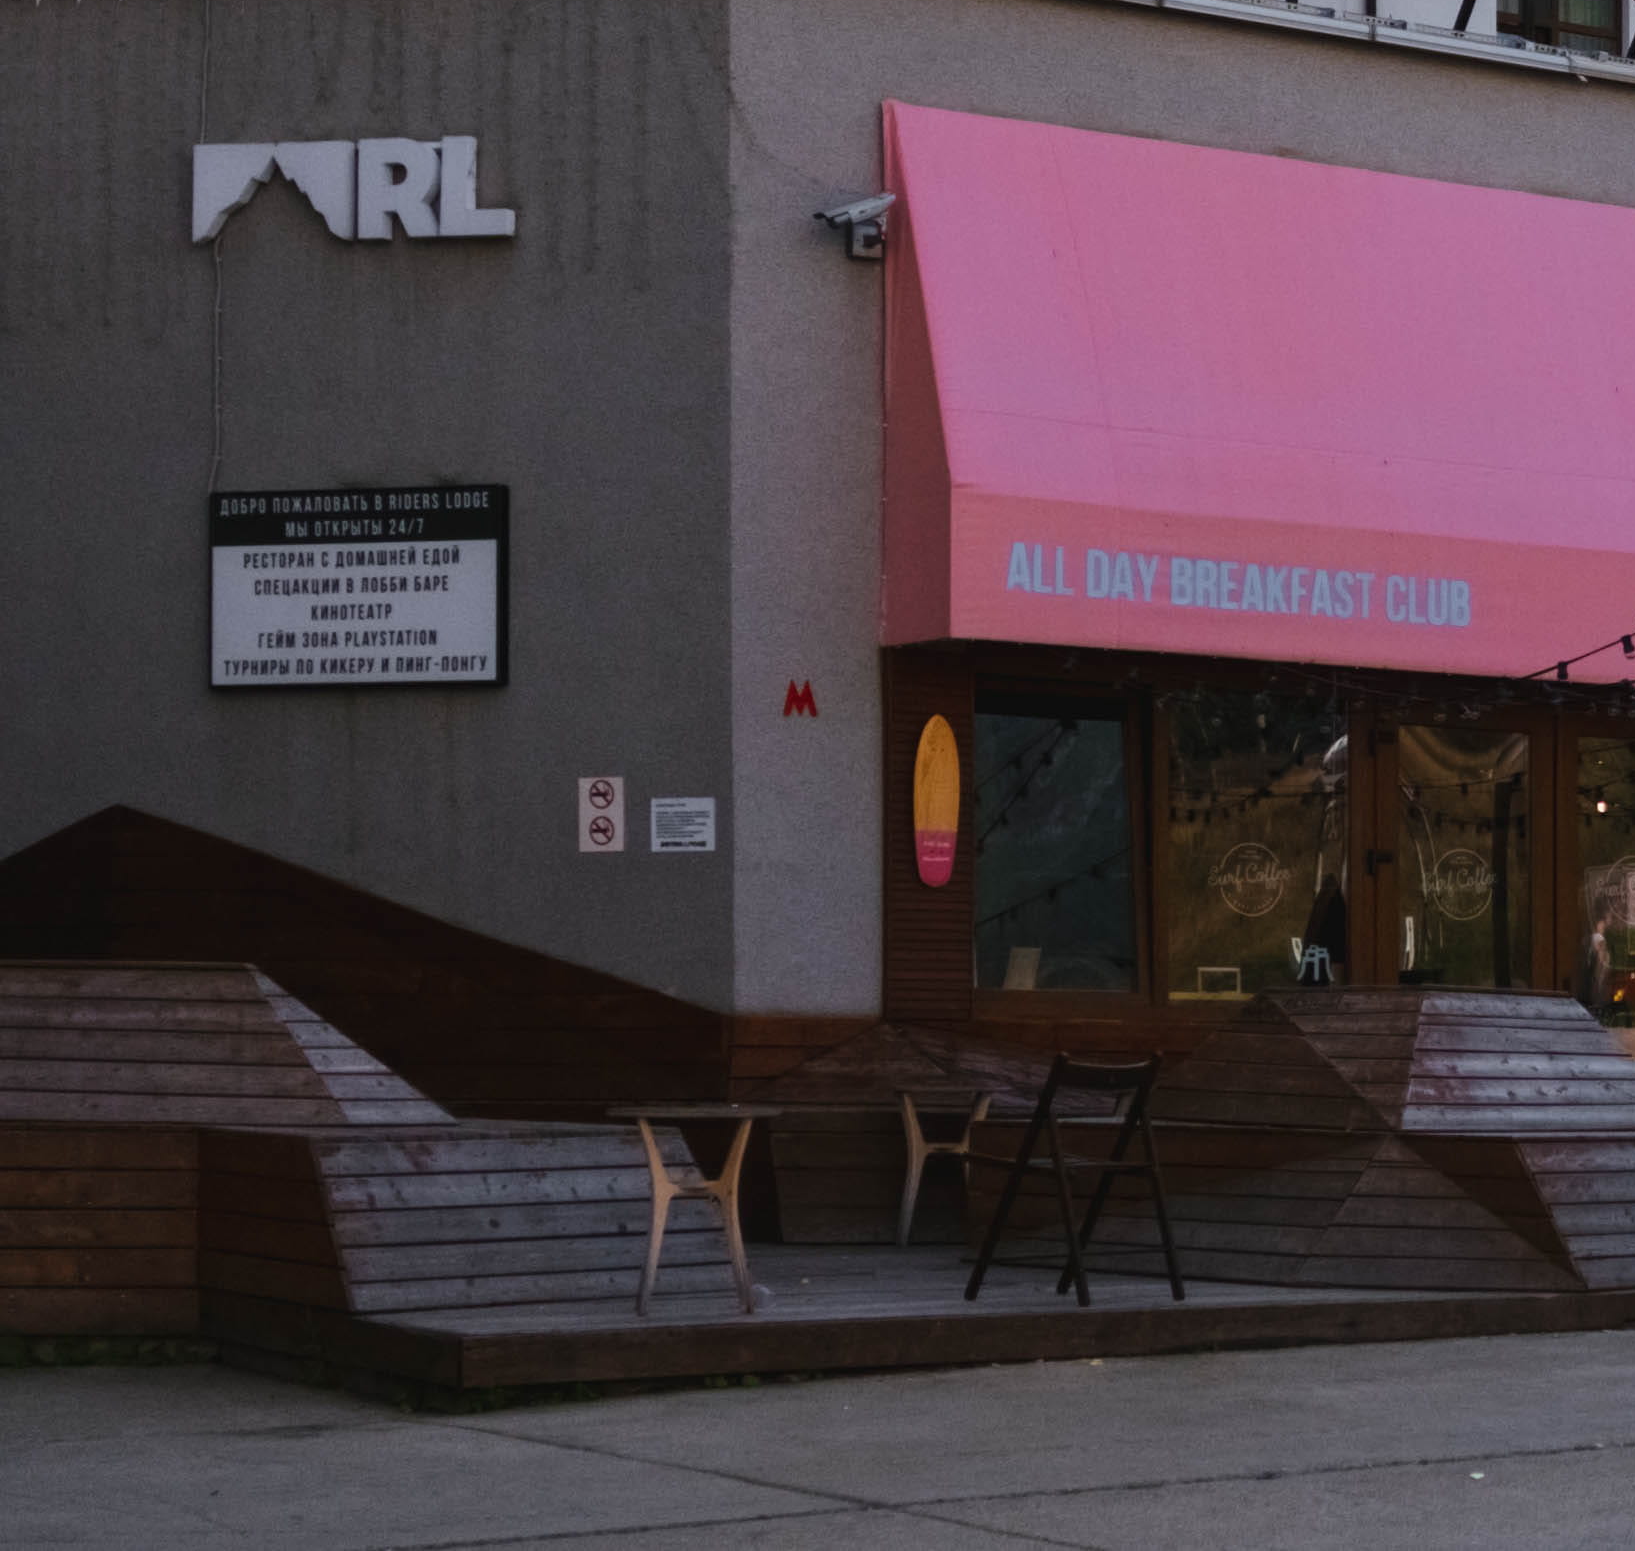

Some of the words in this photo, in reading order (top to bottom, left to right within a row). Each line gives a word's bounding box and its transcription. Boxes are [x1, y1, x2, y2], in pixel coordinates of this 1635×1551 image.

[220, 497, 266, 517] ДОБРО
[273, 494, 368, 514] ПОЖАЛОВАТЬ
[374, 494, 383, 511] В
[389, 492, 440, 511] RIDERS
[445, 491, 489, 510] LODGE
[285, 521, 308, 538] МЫ
[314, 518, 383, 537] ОТКРЫТЫ
[389, 518, 425, 536] 24/7
[243, 551, 314, 569] РЕСТОРАН
[321, 551, 329, 566] С
[335, 546, 416, 569] ДОМАШНЕЙ
[423, 545, 460, 565] ЕДОЙ
[254, 577, 340, 597] СПЕЦАКЦИИ
[346, 577, 354, 592] В
[360, 576, 407, 593] ЛОББИ
[413, 575, 449, 591] БАРЕ
[1006, 541, 1075, 596] ALL
[1085, 548, 1159, 603] DAY
[1169, 555, 1375, 619] BREAKFAST
[1386, 575, 1472, 627] CLUB
[311, 604, 393, 621] КИНОТЕАТР
[258, 630, 296, 649] ГЕЙМ
[302, 632, 338, 648] ЗОНА
[344, 629, 438, 647] PLAYSTATION
[224, 659, 289, 676] ТУРНИРЫ
[296, 658, 313, 674] ПО
[320, 657, 374, 674] КИКЕРУ
[381, 657, 389, 672] И
[395, 655, 488, 673] ПИНГ-ПОНГУ
